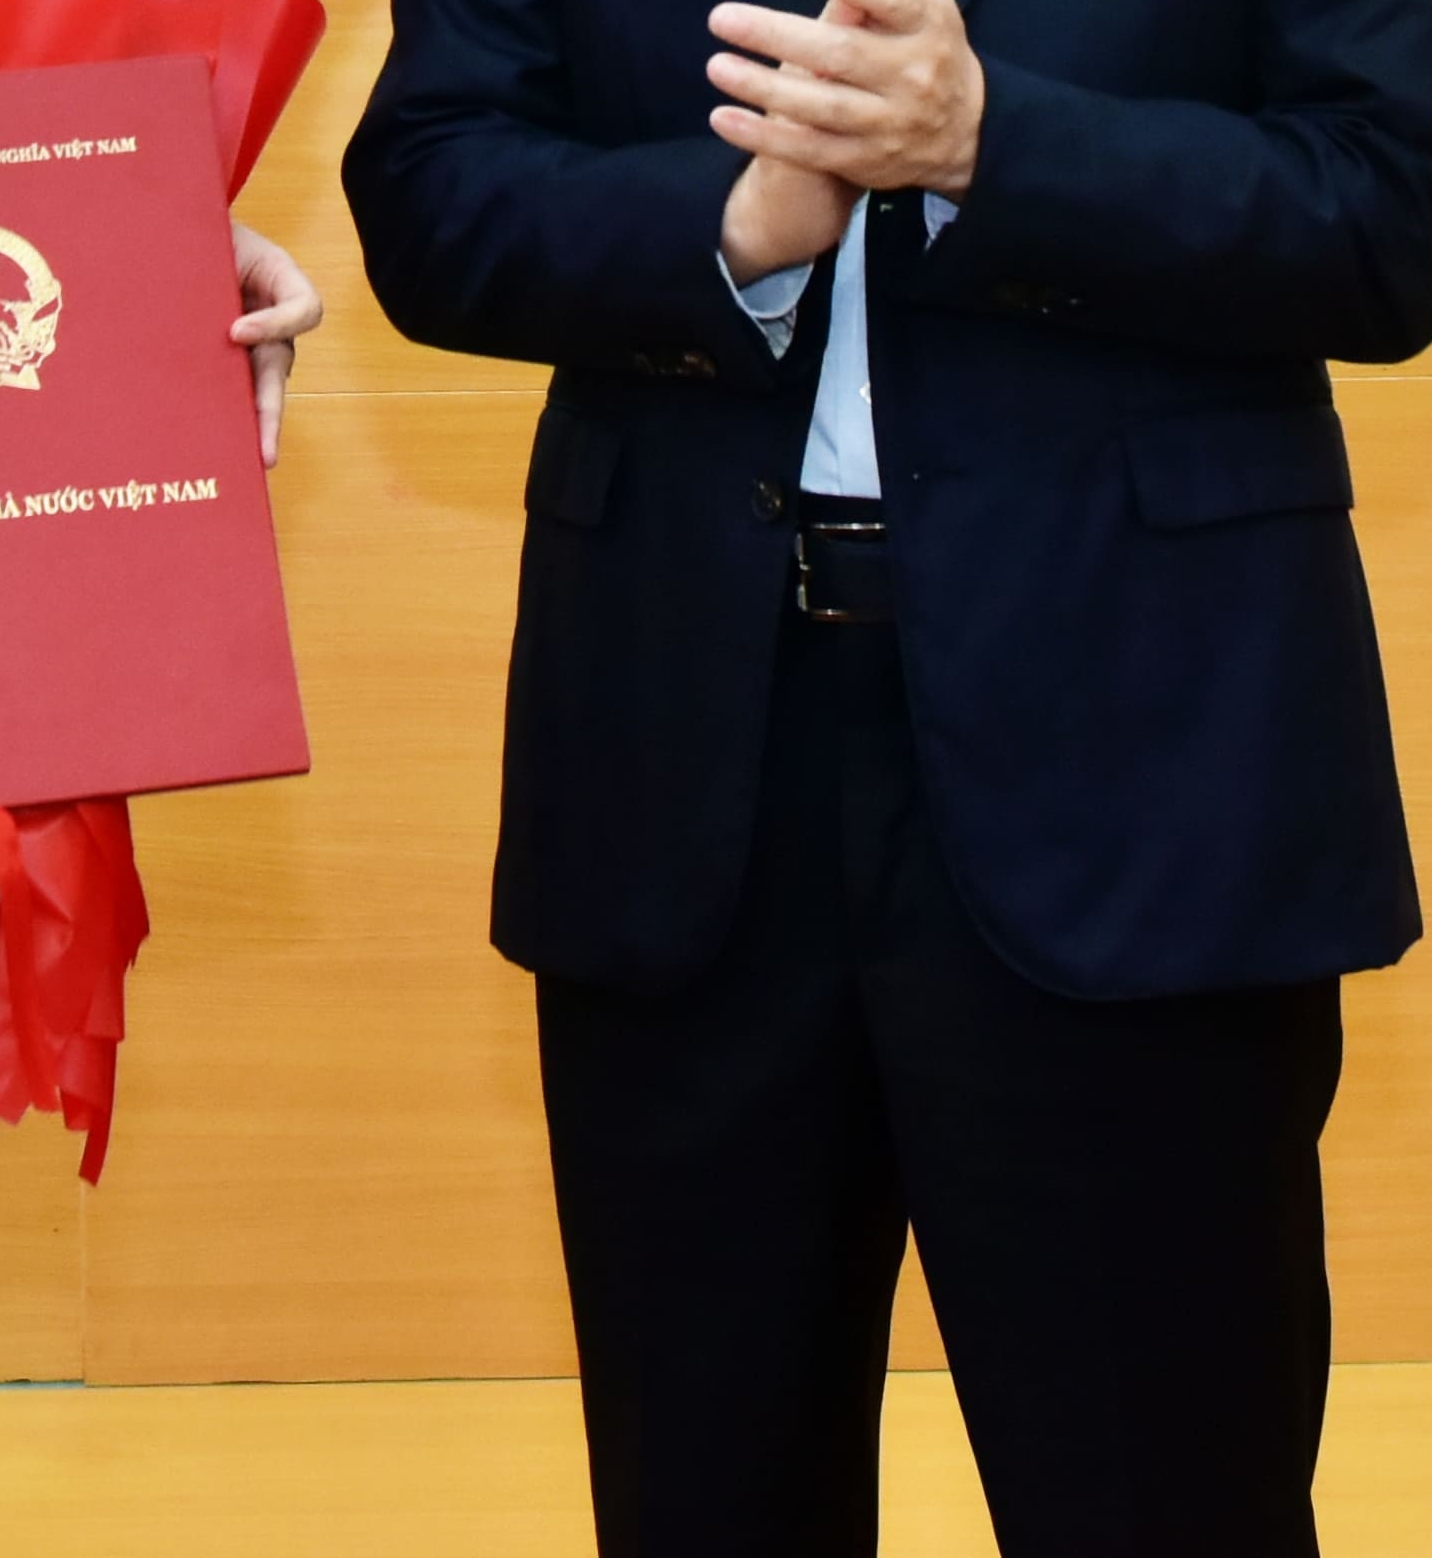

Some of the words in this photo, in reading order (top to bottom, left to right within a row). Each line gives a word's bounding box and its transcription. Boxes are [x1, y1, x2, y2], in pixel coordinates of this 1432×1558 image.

[53, 138, 94, 161] VIỆT
[96, 135, 137, 155] NAM
[23, 485, 95, 516] NƯỚC
[98, 479, 158, 511] VIỆT
[161, 477, 219, 504] NAM
